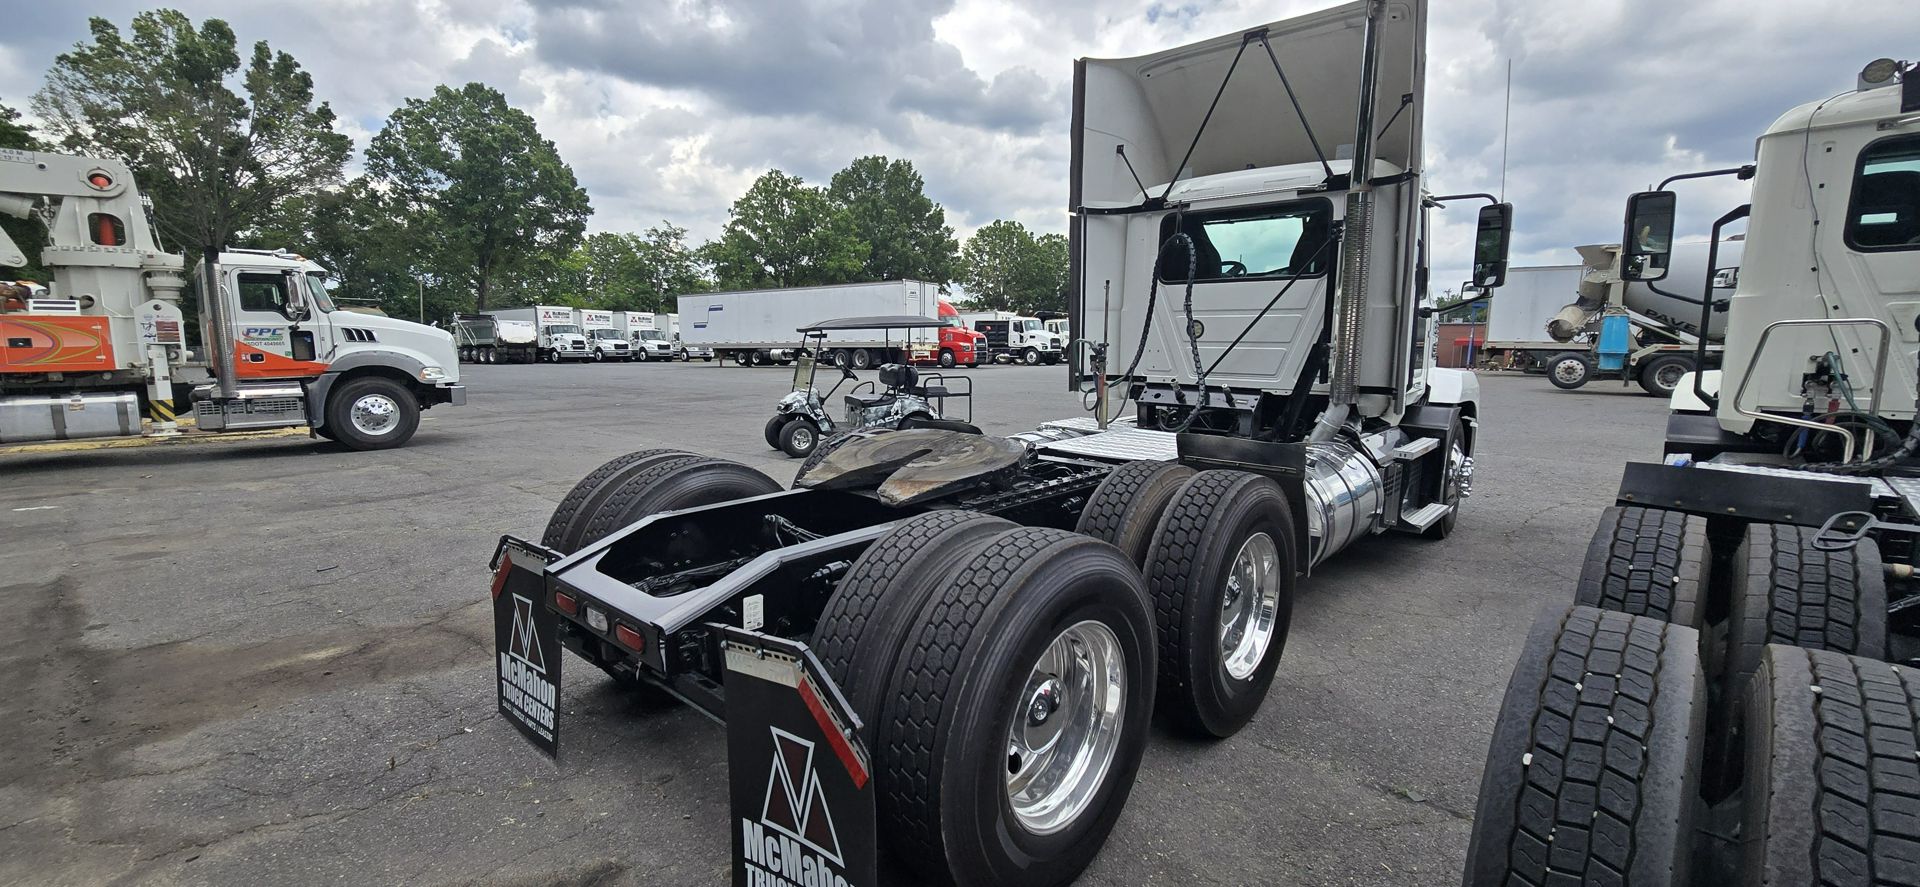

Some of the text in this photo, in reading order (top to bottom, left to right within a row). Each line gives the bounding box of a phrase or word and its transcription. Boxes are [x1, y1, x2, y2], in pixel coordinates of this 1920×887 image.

[246, 327, 285, 336] PPC
[1644, 308, 1698, 332] PAVE
[865, 414, 904, 428] MACK
[501, 651, 555, 710] McMahon
[502, 679, 555, 731] TRUCK CENTERS
[743, 817, 855, 887] McMah
[745, 862, 799, 887] TRU
